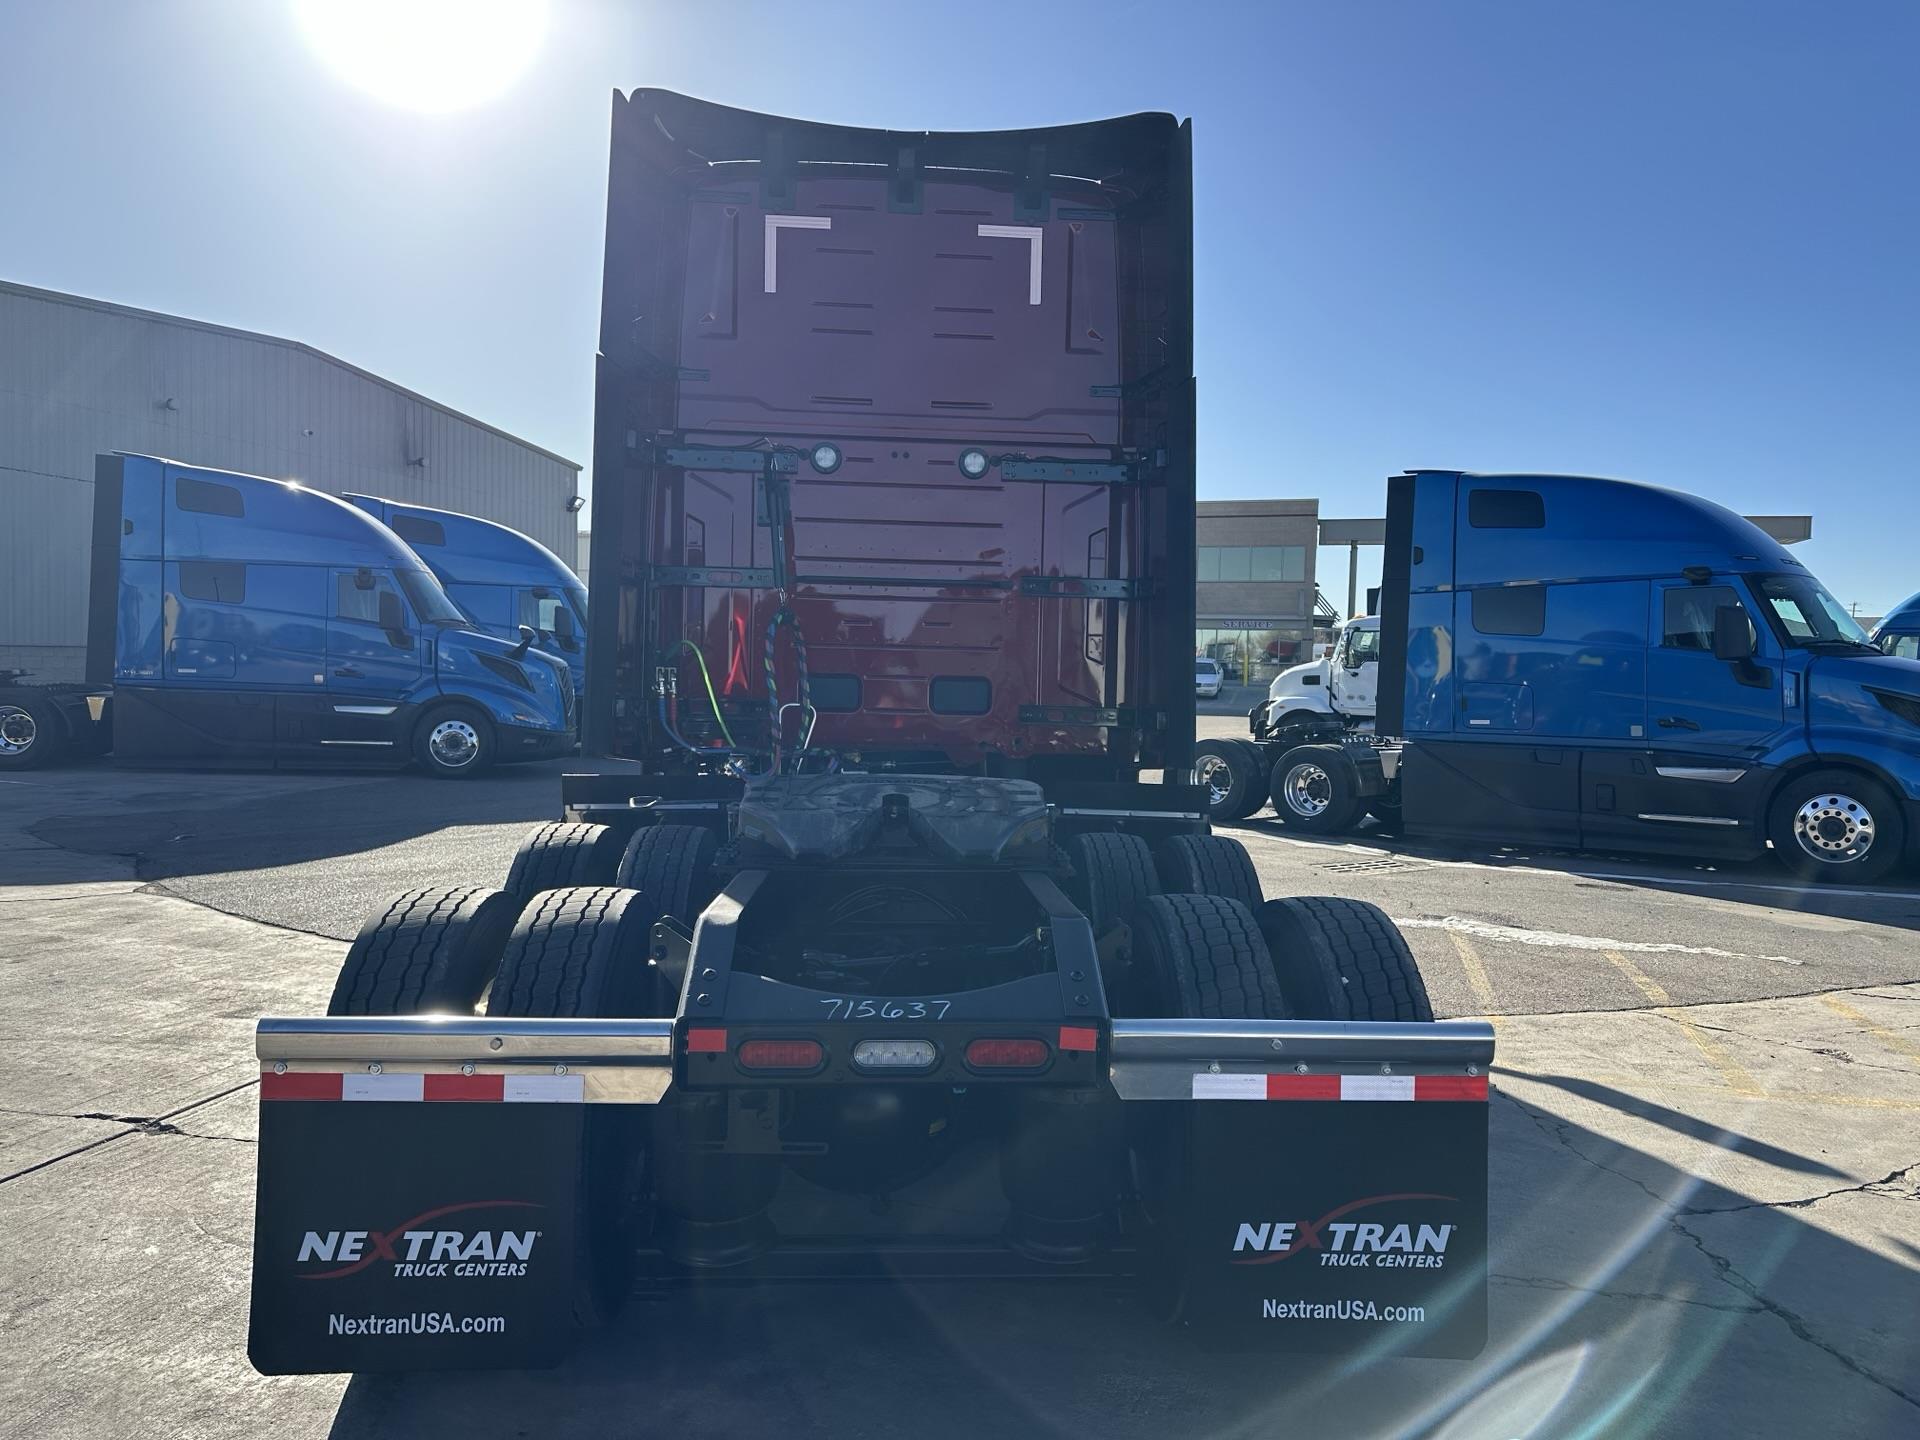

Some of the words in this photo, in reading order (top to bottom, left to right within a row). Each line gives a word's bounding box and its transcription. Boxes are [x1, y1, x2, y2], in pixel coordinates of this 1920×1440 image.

[820, 998, 951, 1020] 715637
[297, 1231, 537, 1262] NEXTRAN
[1233, 1220, 1451, 1253] NEXTRAN
[394, 1263, 447, 1277] TRUCK
[454, 1263, 528, 1277] CENTERS
[1320, 1253, 1369, 1267] TRUCK
[1375, 1254, 1444, 1268] CENTERS
[1263, 1299, 1425, 1322] NextranUSA.com
[328, 1312, 505, 1335] NextranUSA.com
